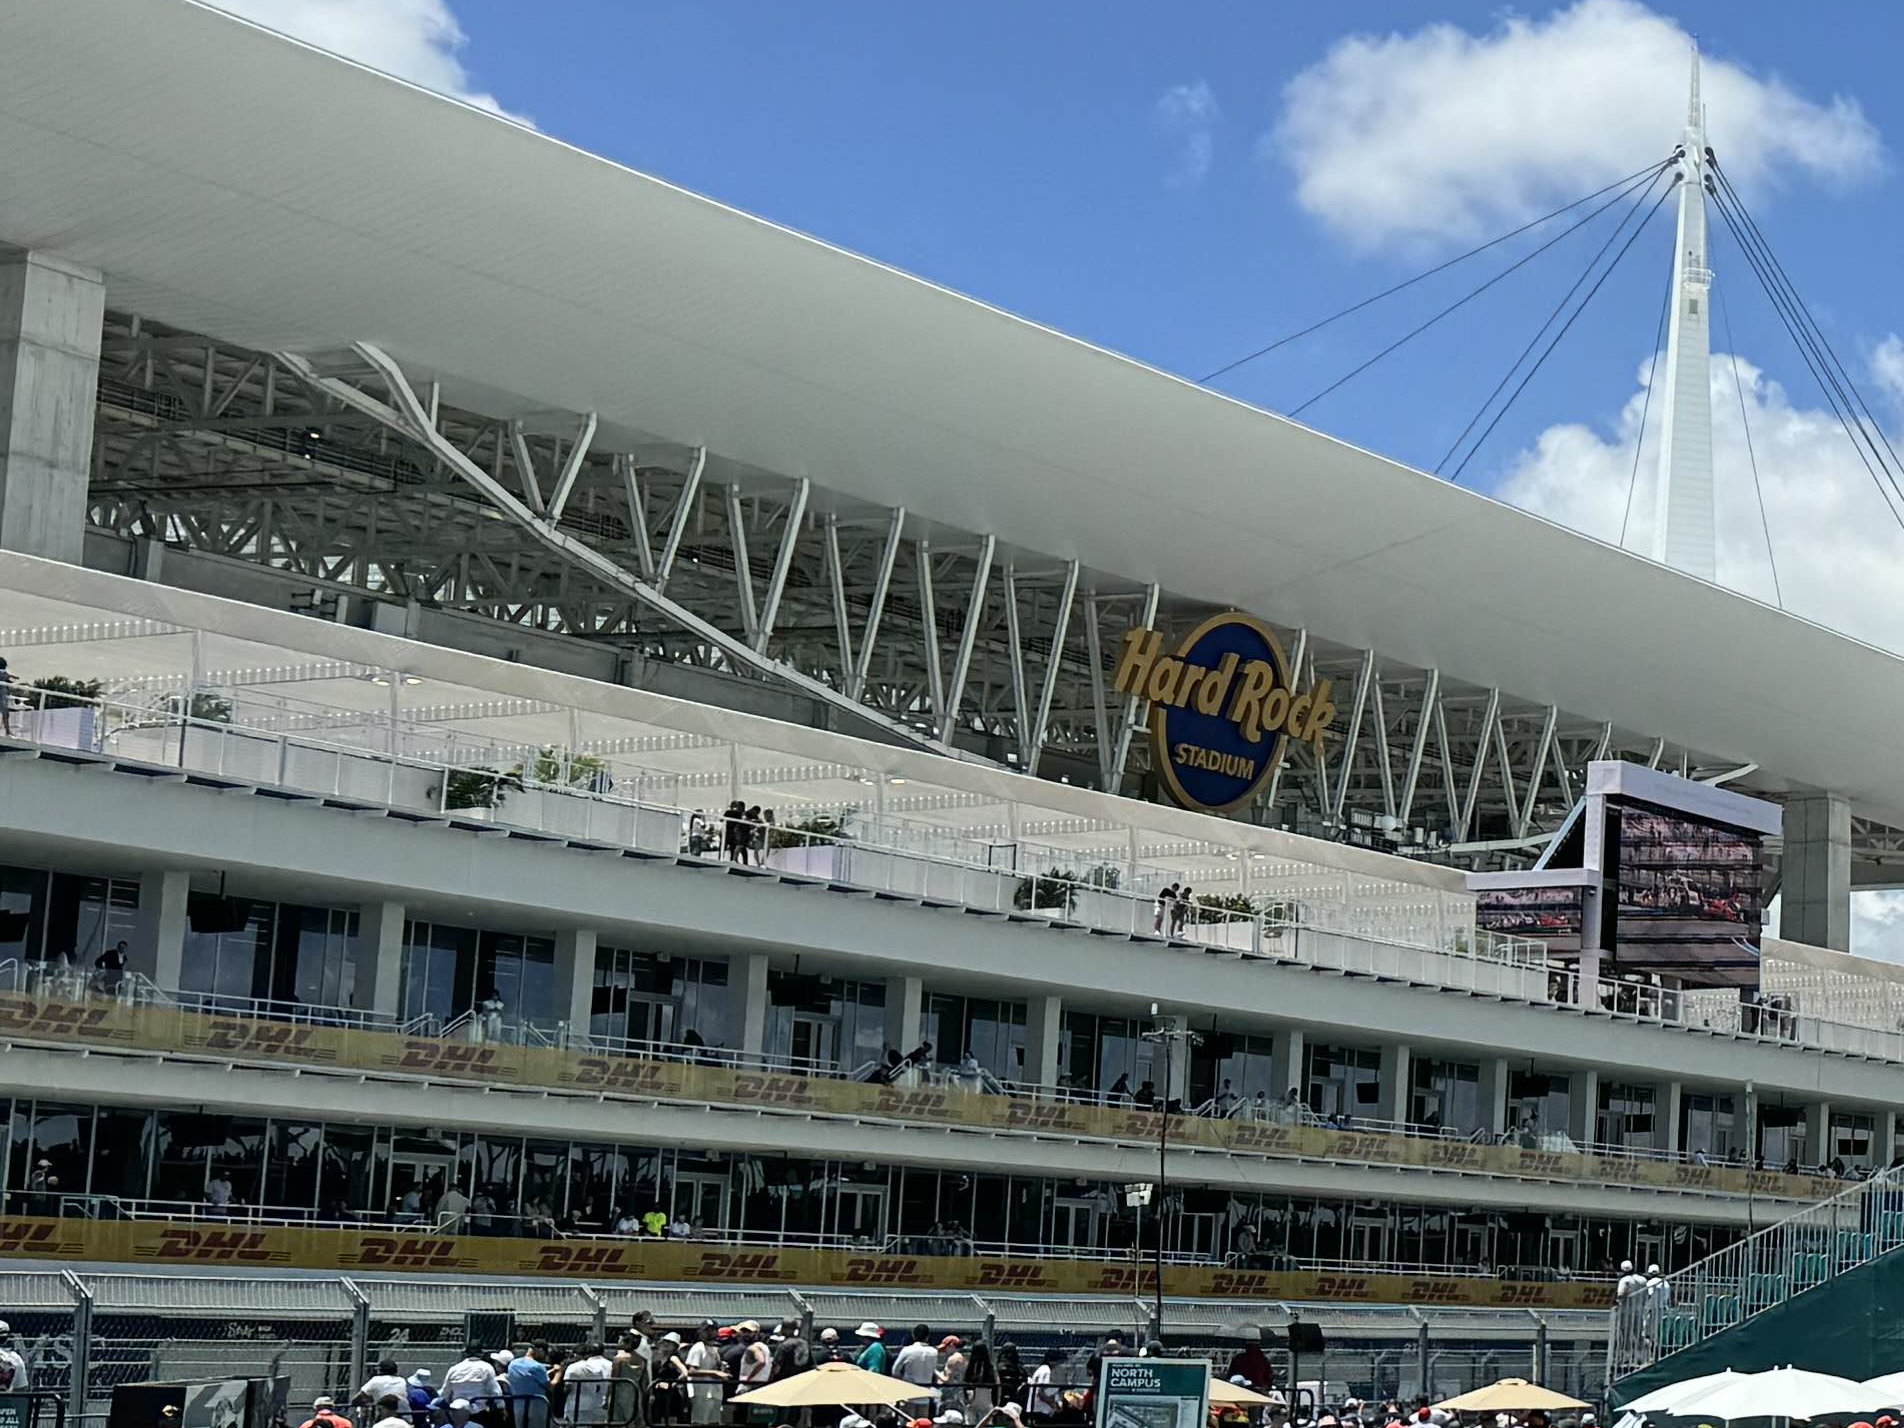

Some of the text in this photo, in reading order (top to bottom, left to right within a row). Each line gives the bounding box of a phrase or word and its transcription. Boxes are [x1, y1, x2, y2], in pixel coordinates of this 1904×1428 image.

[1114, 627, 1337, 758] Hard Rock
[1174, 743, 1255, 780] STADIUM
[401, 1041, 500, 1073] DHL
[575, 1058, 666, 1091] DHL
[733, 1074, 813, 1105] DHL
[0, 1222, 60, 1253] HL
[157, 1229, 276, 1262] DHL
[356, 1237, 466, 1267] DHL
[536, 1246, 634, 1273] DHL
[697, 1253, 788, 1278] DHL
[844, 1258, 932, 1283] DHL
[976, 1263, 1051, 1286] DHL
[1211, 1273, 1269, 1294] DHL
[1315, 1277, 1370, 1297] DHL
[1110, 1378, 1161, 1388] CAMPUS
[1111, 1368, 1153, 1378] NORTH
